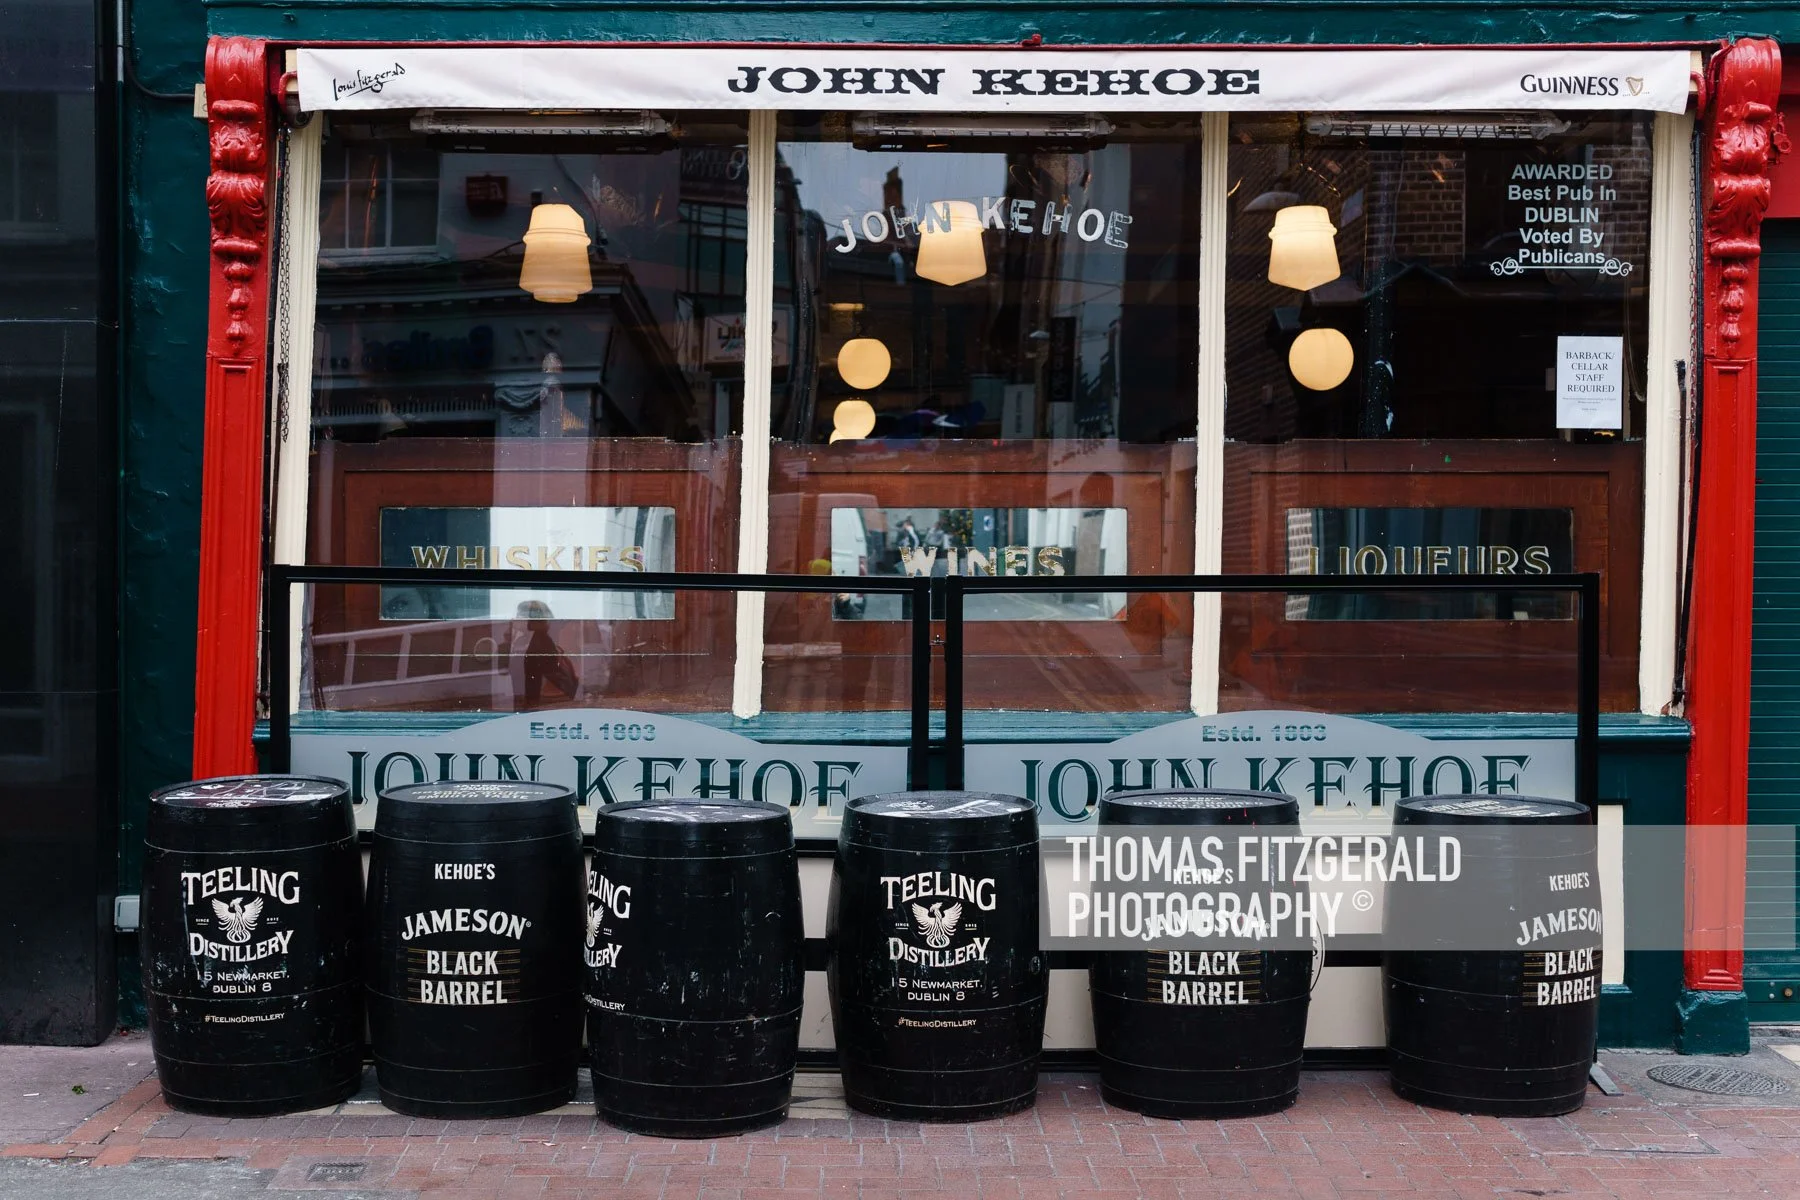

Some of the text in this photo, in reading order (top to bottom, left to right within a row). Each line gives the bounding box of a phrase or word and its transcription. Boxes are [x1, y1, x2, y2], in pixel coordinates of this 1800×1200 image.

[727, 66, 1261, 96] JOHN KEHOE
[1520, 74, 1619, 96] GUINNESS
[1511, 164, 1613, 180] AWARDED
[1508, 185, 1617, 201] Best Pub In
[835, 196, 1133, 254] JOHN KEHOE
[1525, 207, 1599, 223] DUBLIN
[1519, 228, 1605, 248] Voted By
[1518, 248, 1606, 264] Publicans
[1566, 351, 1616, 360] BARBACK/
[1571, 362, 1609, 371] CELLAR
[1575, 373, 1605, 382] STAFF
[1567, 384, 1615, 393] REQUIRED
[899, 545, 1066, 577] WINES
[530, 721, 656, 741] Estd. 1803
[1202, 724, 1327, 742] Estd. 1803
[435, 863, 496, 880] KEHOE'S
[1549, 872, 1590, 891] KEHOE'S
[181, 866, 300, 905] TEELING
[587, 870, 632, 919] ELING
[880, 871, 997, 911] TEELING
[189, 930, 294, 963] DISTILLERY
[888, 937, 991, 968] DISTILLERY
[427, 950, 499, 976] BLACK
[1168, 950, 1241, 976] BLACK
[1544, 946, 1594, 976] BLACK
[212, 982, 272, 994] DUBLIN 8
[421, 979, 508, 1006] BARREL
[907, 991, 965, 1002] DUBLIN 8
[1162, 980, 1249, 1005] BARREL
[1537, 975, 1597, 1006] BARREL
[204, 1013, 285, 1023] #TEELINGDISTILLERY
